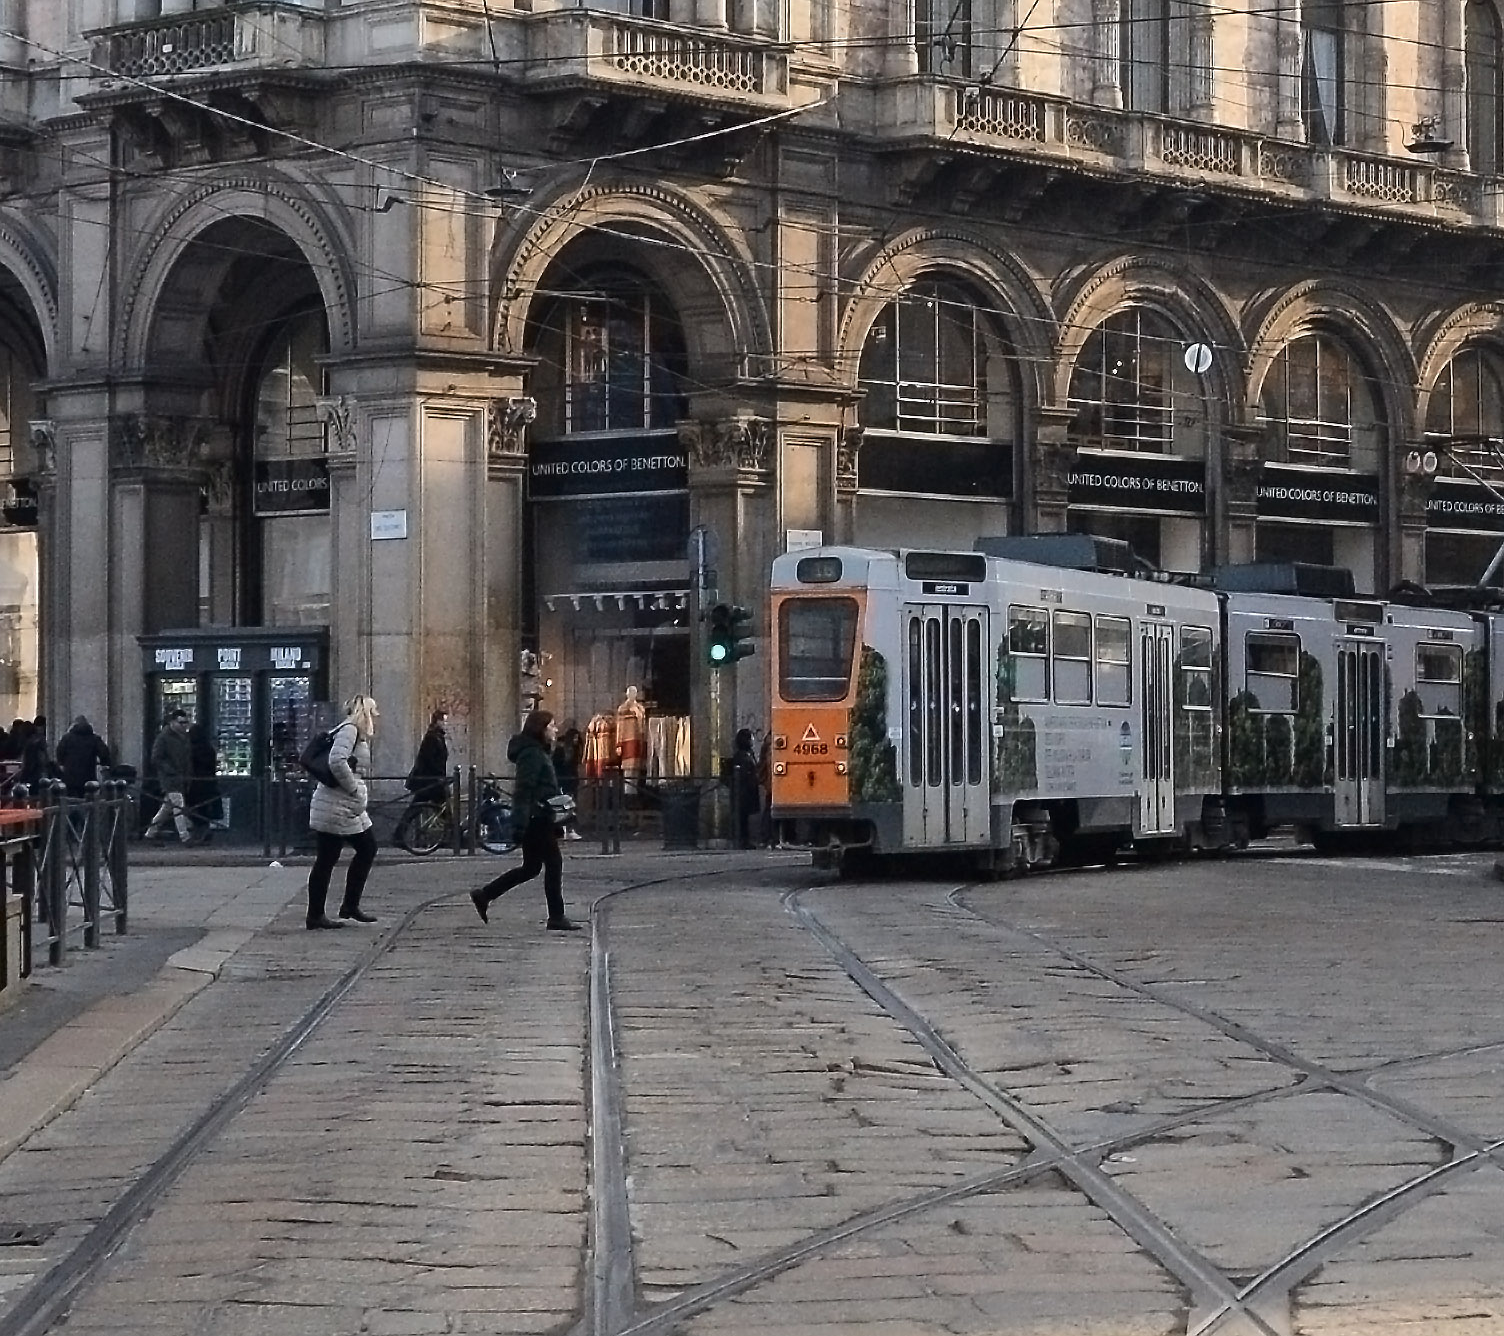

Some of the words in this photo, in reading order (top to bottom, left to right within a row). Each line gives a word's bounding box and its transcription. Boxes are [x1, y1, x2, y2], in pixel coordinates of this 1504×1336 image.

[532, 462, 568, 476] UNITED
[571, 460, 612, 474] COLORS
[614, 458, 628, 471] OF
[258, 480, 289, 493] UNITED
[292, 477, 328, 491] COLORS
[1067, 473, 1102, 486] UNITED
[1104, 475, 1141, 489] COLORS
[1143, 477, 1155, 490] OF
[1256, 486, 1287, 499] UNITED
[1289, 488, 1321, 501] COLORS
[1323, 490, 1334, 502] OF
[1426, 500, 1452, 511] UNITED
[1454, 502, 1483, 513] COLORS
[1485, 504, 1495, 514] OF
[794, 743, 828, 755] 4968
